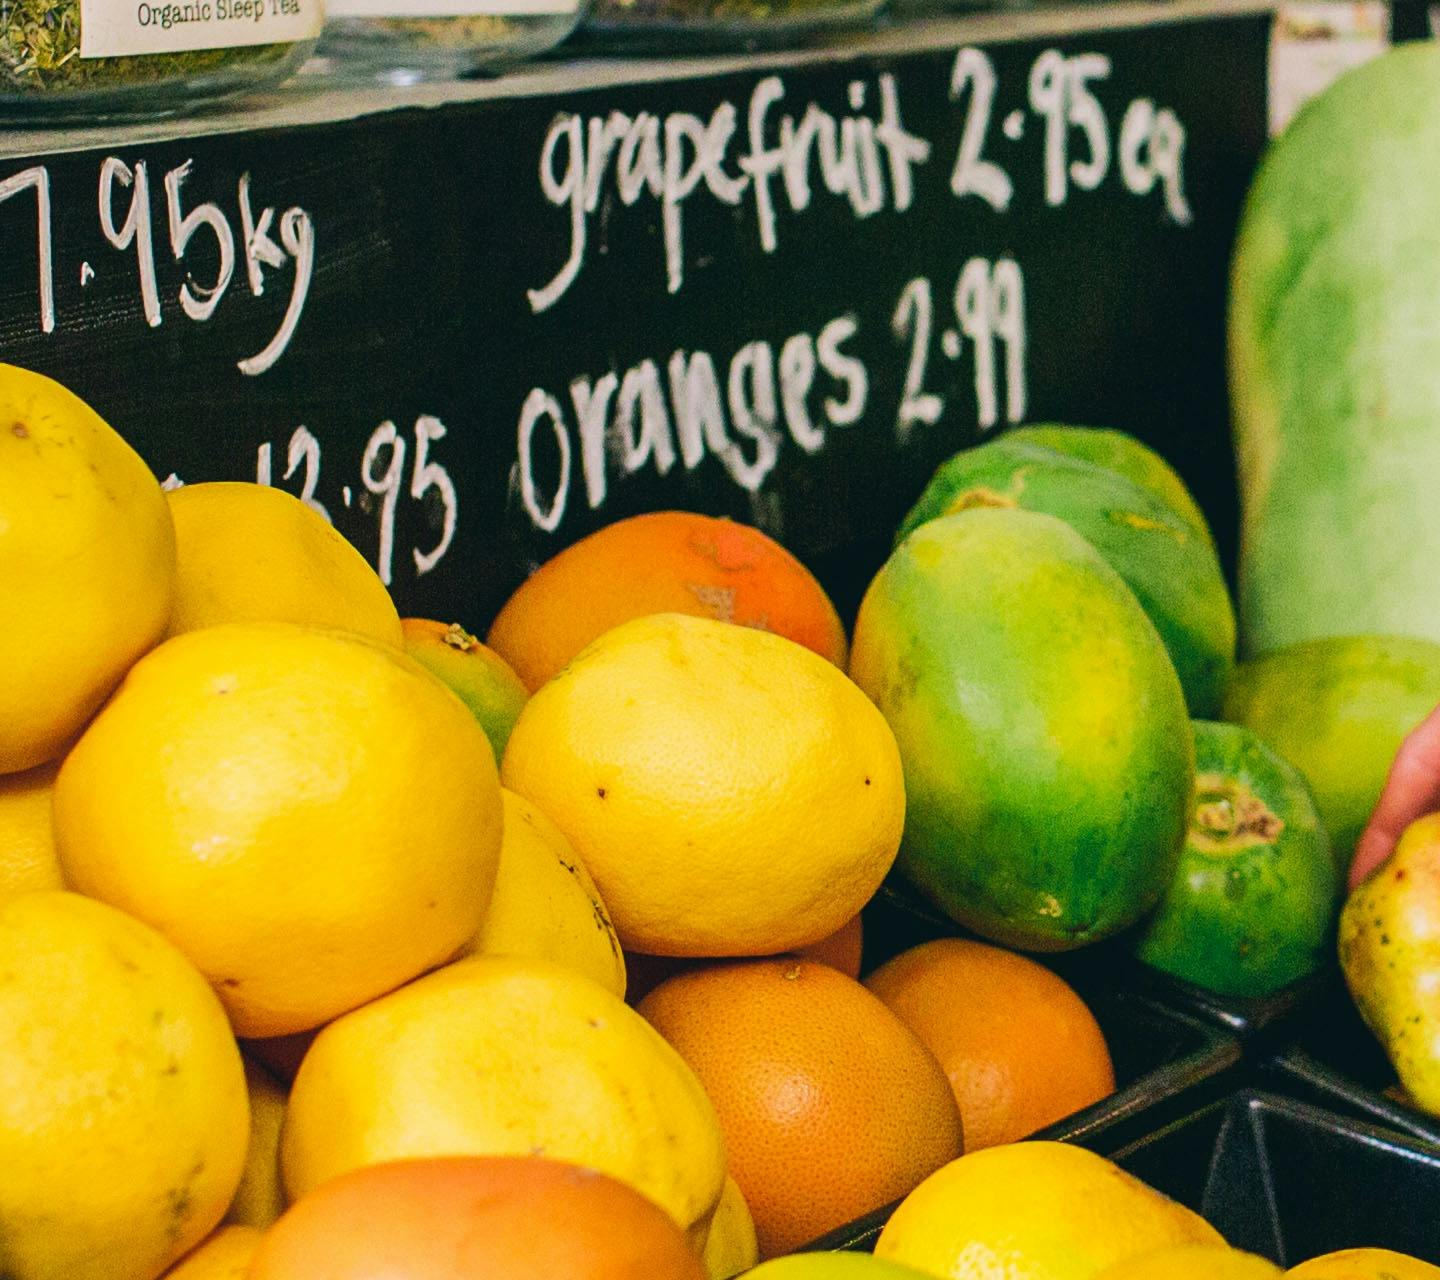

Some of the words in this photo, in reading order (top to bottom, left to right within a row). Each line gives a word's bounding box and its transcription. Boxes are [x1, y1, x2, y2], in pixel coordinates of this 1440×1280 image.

[138, 0, 211, 29] Organic
[526, 72, 930, 314] grapefruit
[515, 314, 869, 532] oranges
[891, 256, 1027, 430] 2.99
